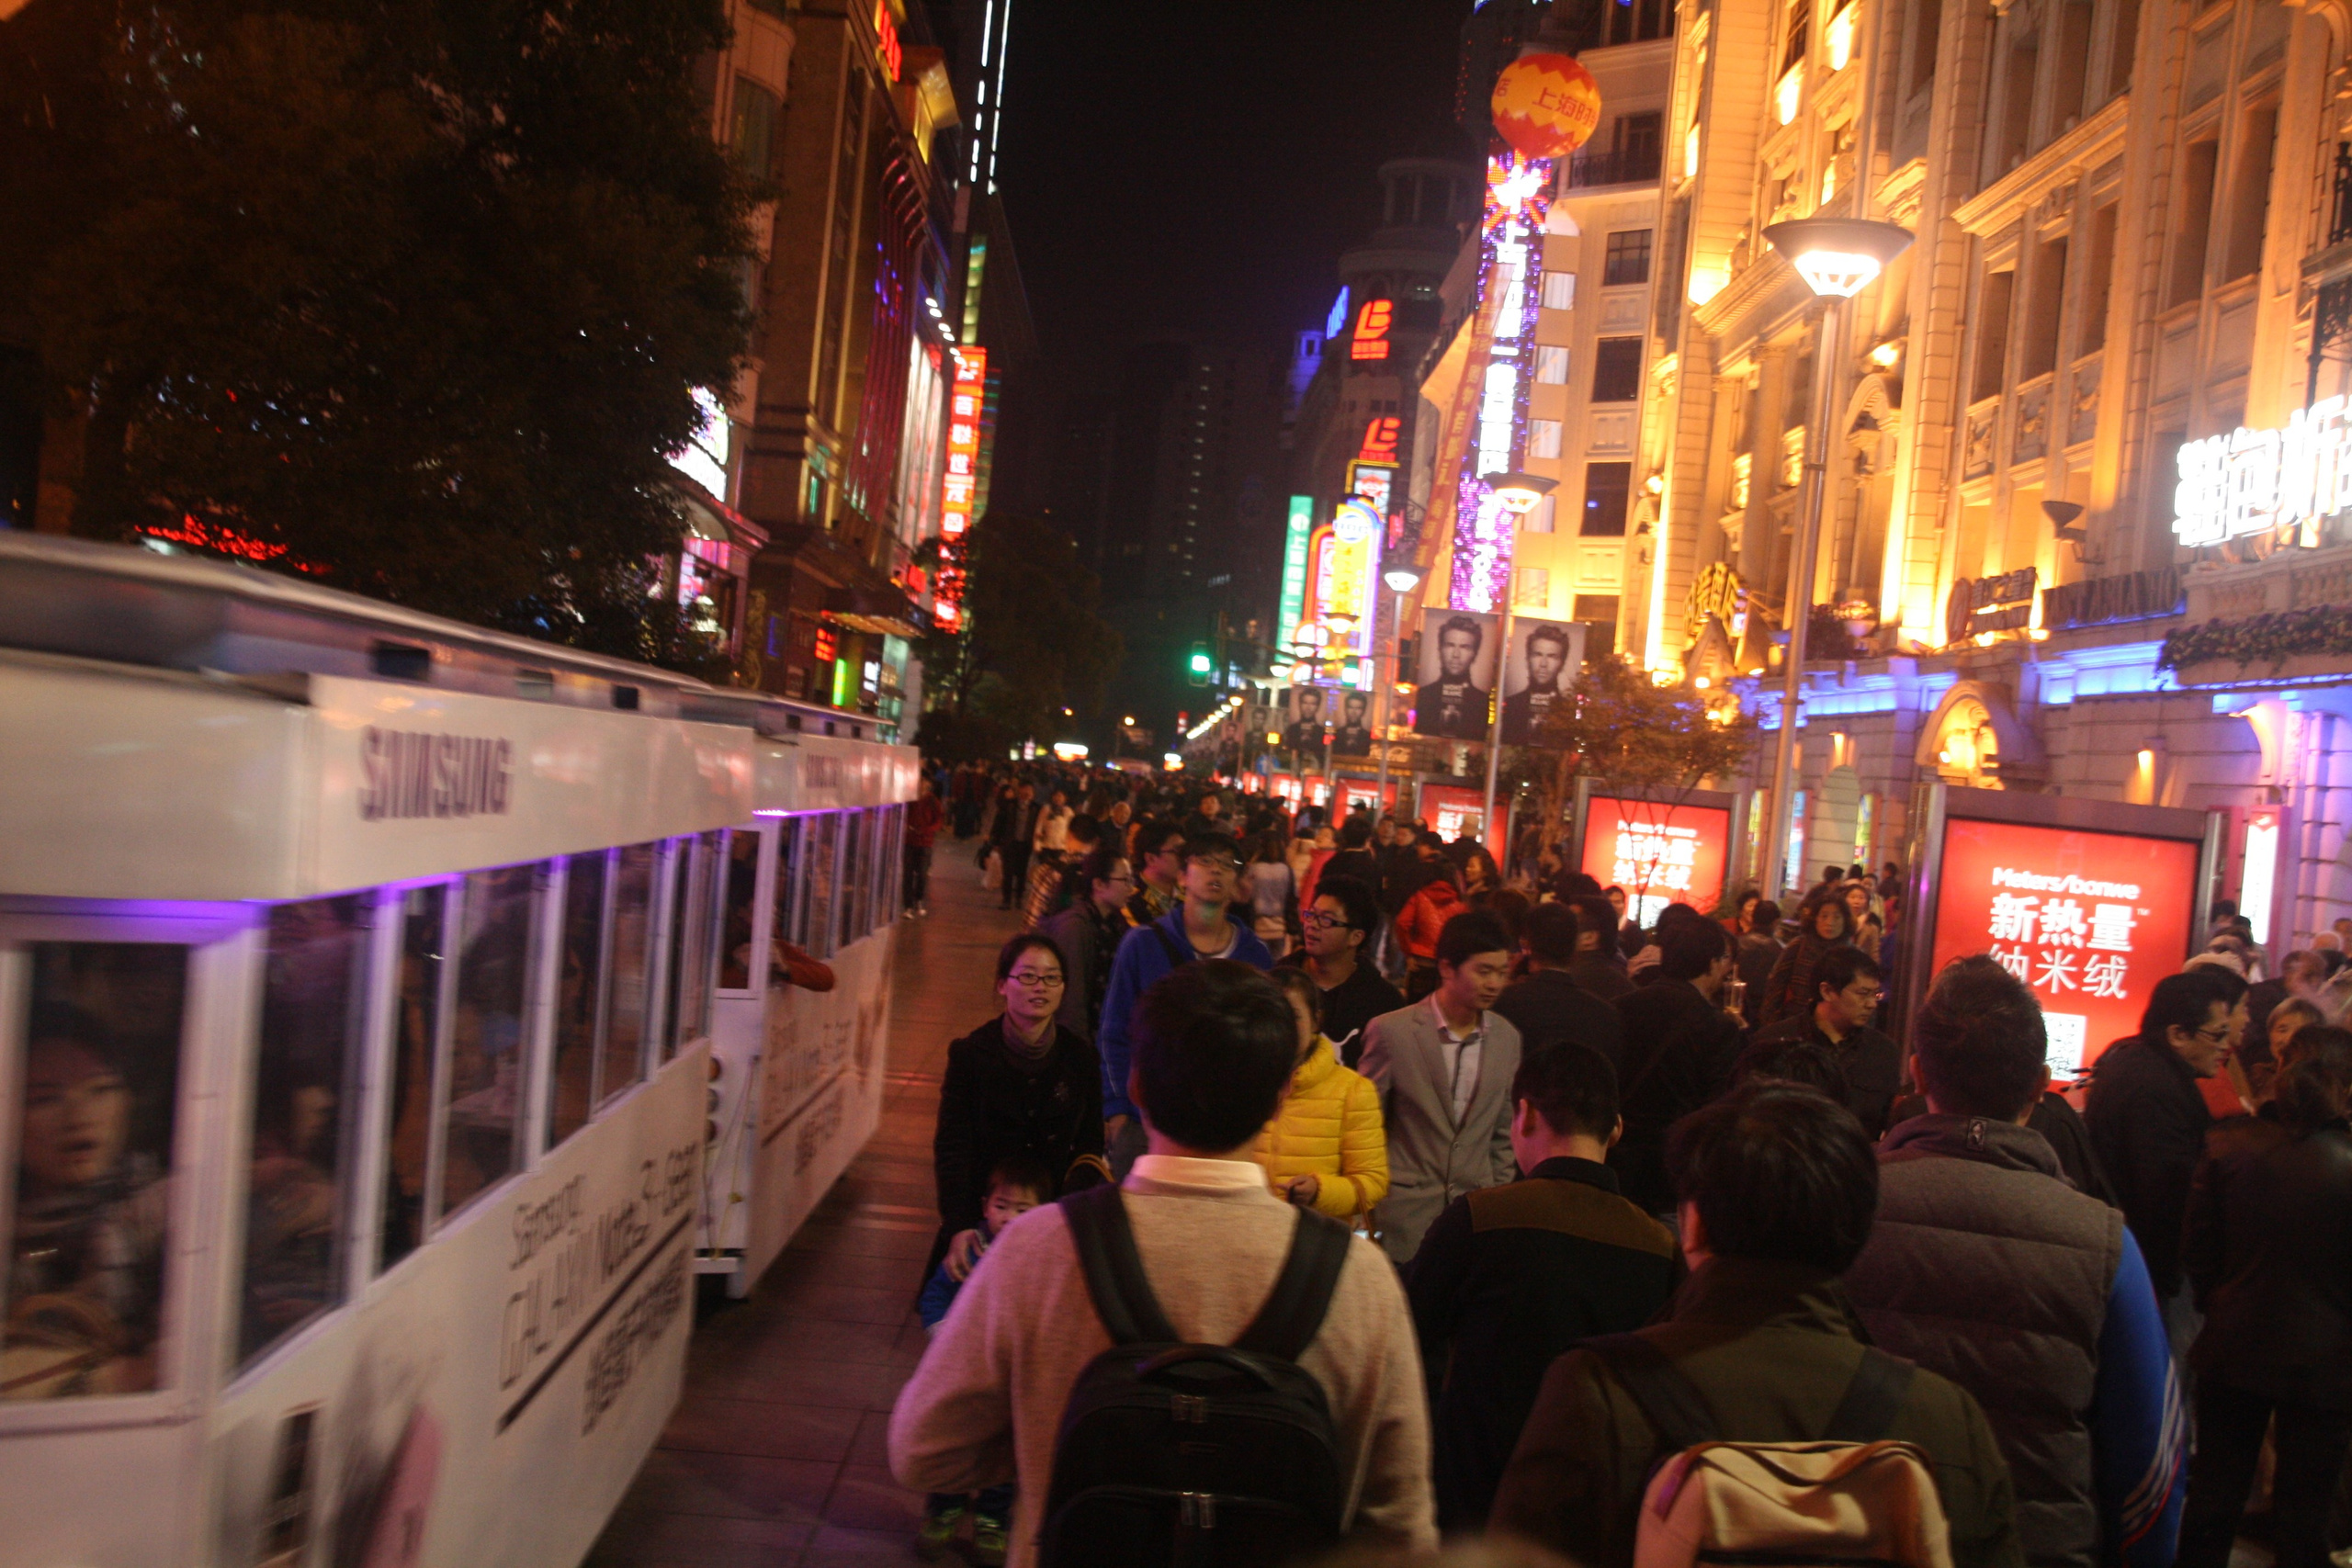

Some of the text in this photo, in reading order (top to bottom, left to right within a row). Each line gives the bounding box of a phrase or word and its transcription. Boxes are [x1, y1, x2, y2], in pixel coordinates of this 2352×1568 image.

[357, 726, 514, 821] SAMSUNG
[1991, 866, 2142, 901] Meters/bonwe
[1987, 892, 2138, 953] 新热量
[1988, 942, 2129, 999] 纳米绒
